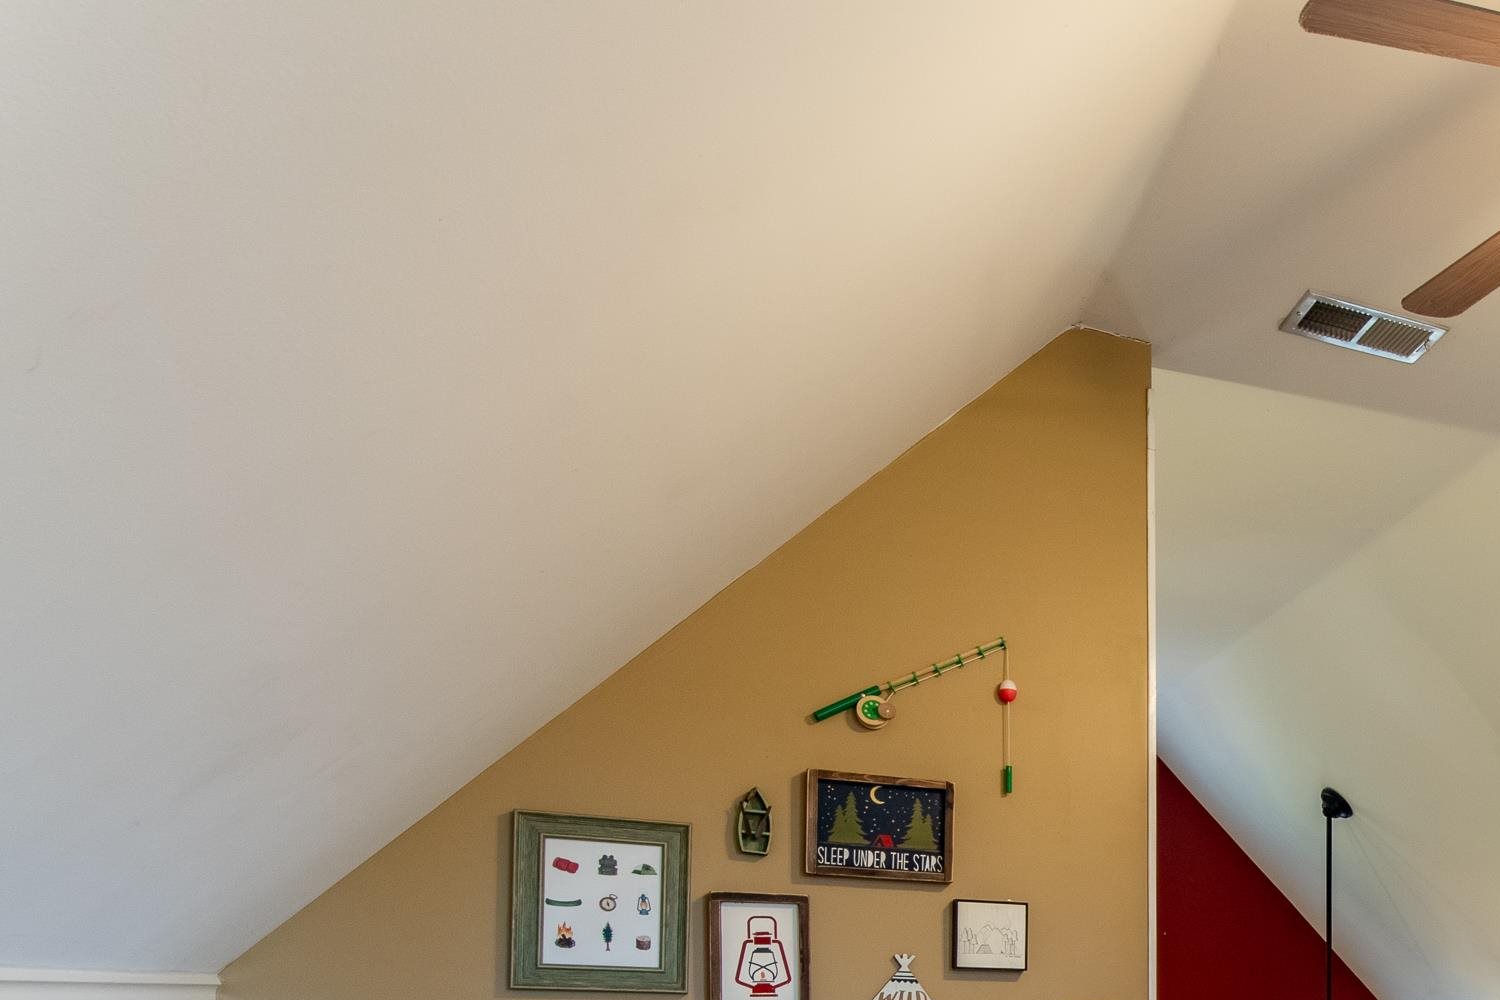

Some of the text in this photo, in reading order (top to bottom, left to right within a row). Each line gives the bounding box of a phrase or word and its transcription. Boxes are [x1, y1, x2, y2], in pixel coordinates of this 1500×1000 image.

[817, 846, 943, 873] SLEEP UNDER THE STARS
